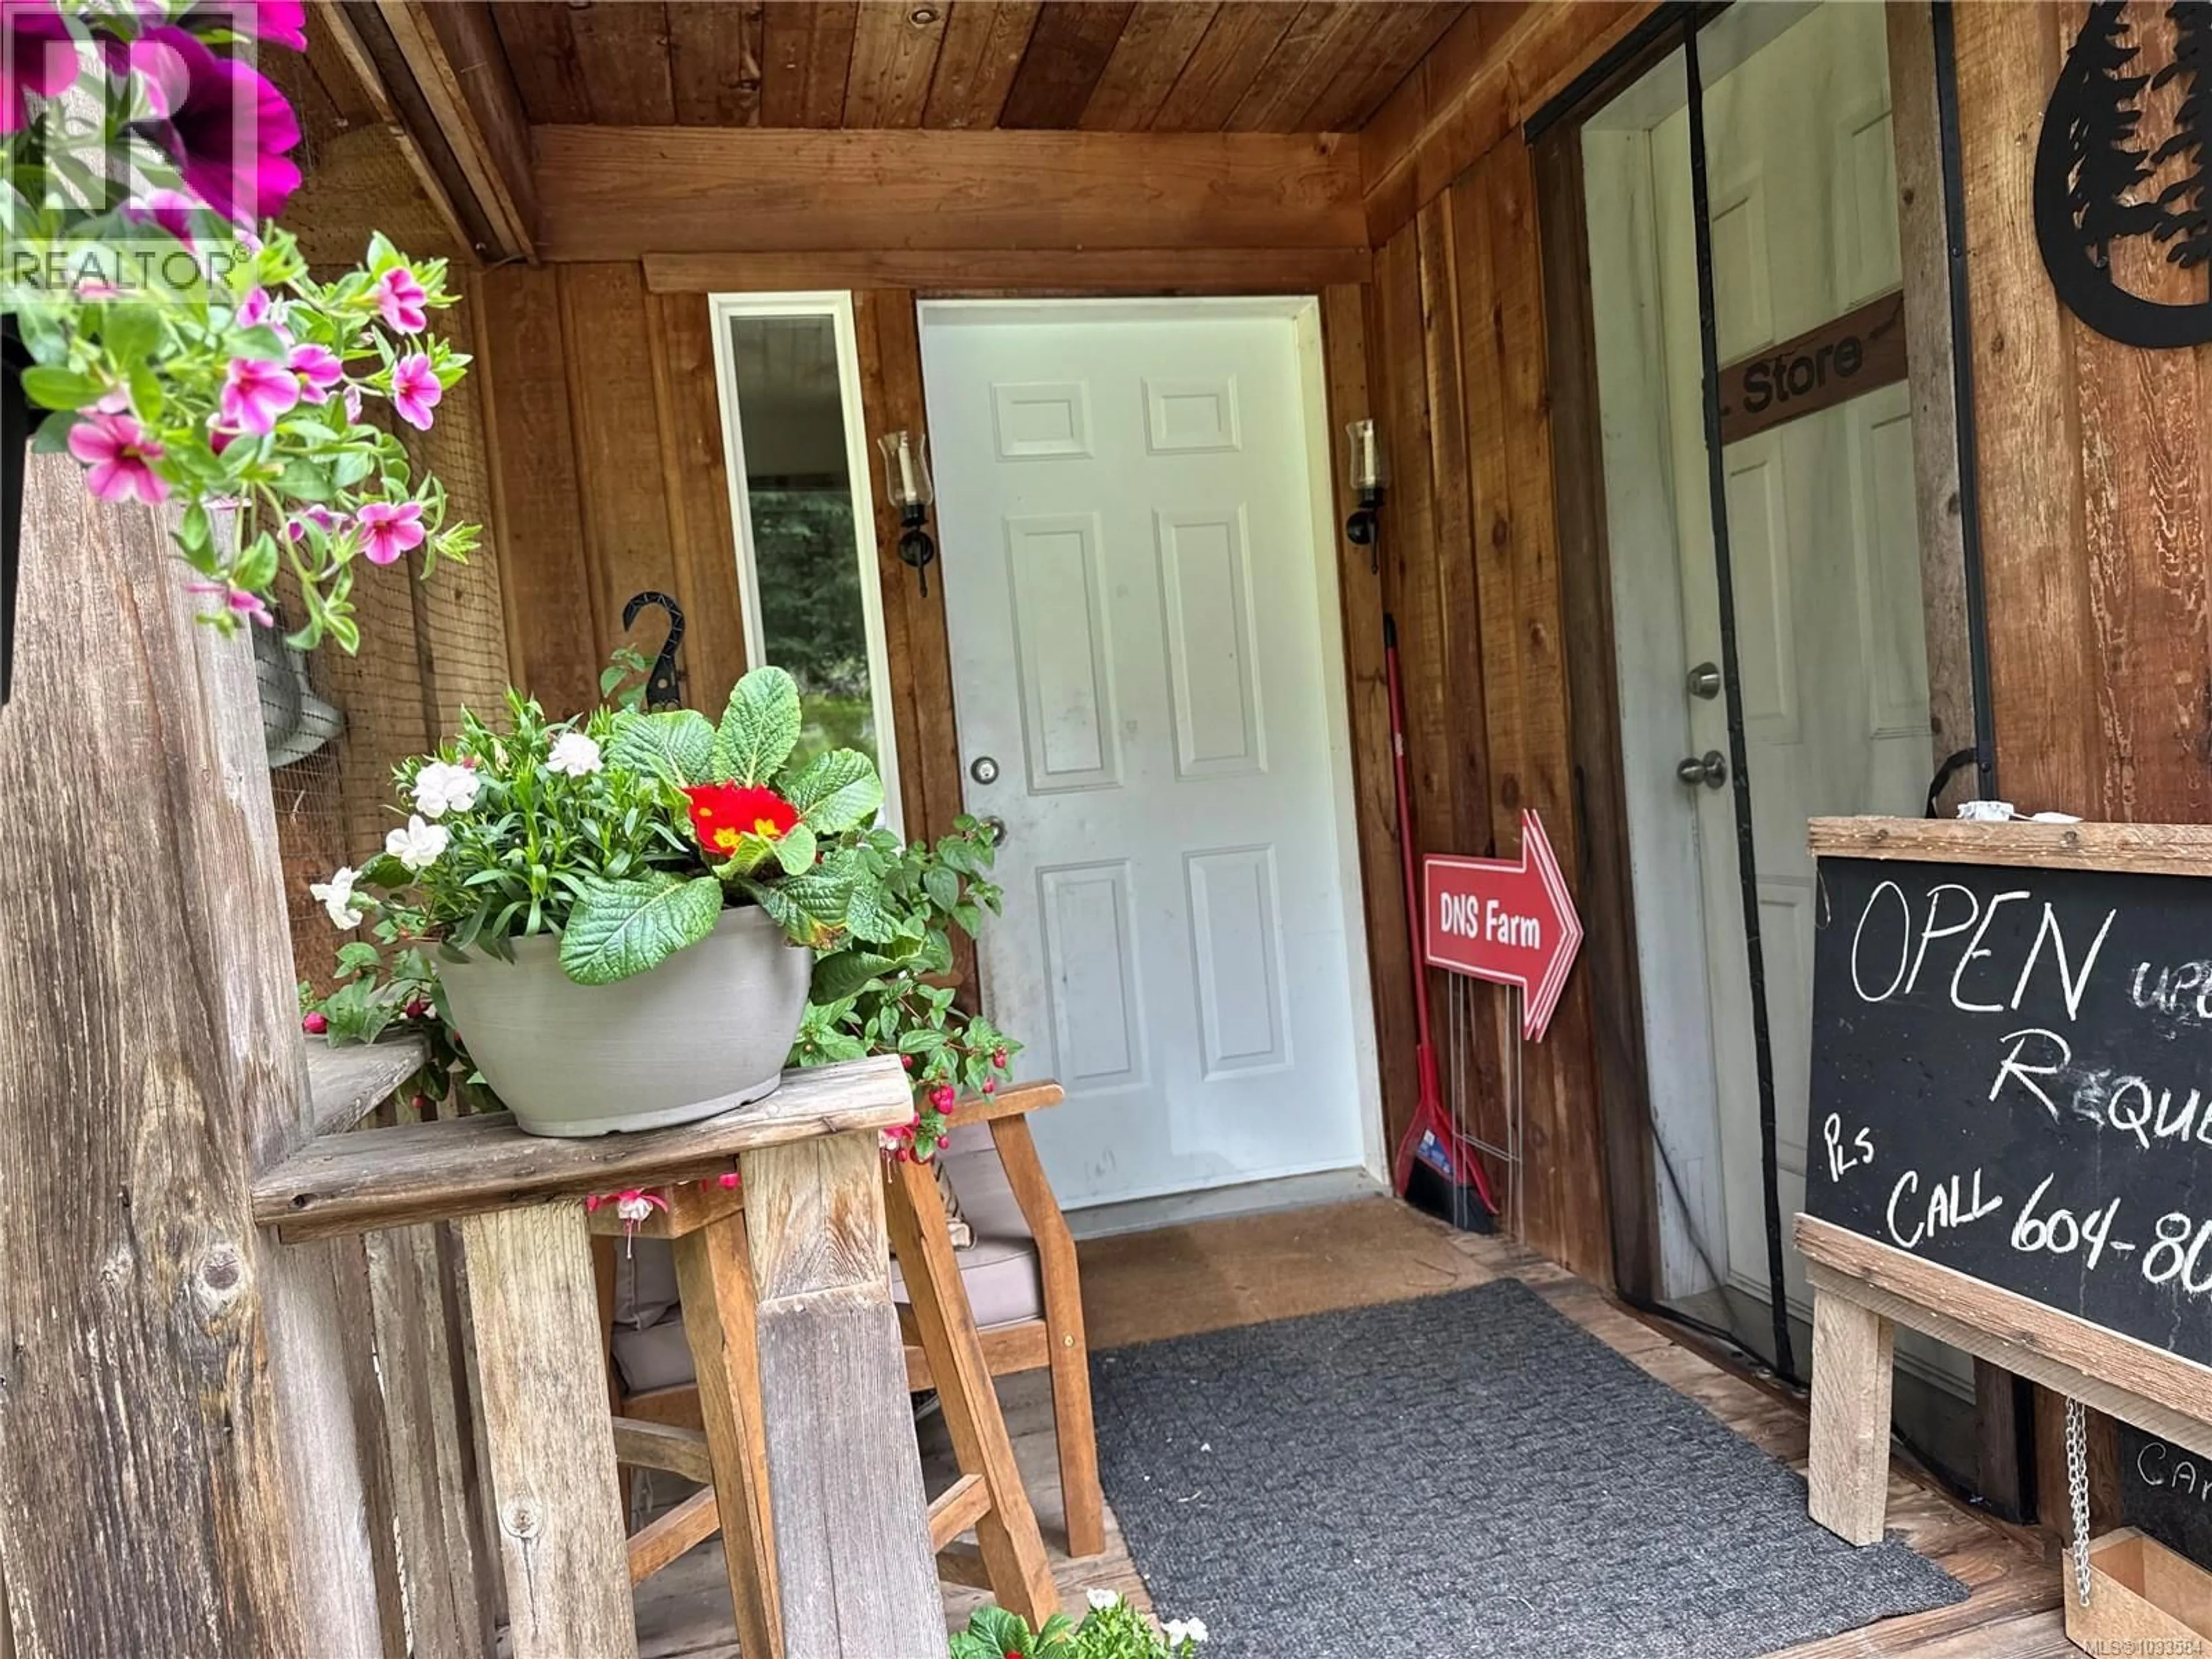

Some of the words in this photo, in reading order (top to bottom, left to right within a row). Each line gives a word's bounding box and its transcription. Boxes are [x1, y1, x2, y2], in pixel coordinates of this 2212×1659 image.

[1743, 336, 1863, 414] Store
[1441, 892, 1478, 939] DNS
[1486, 899, 1540, 950] Farm
[1851, 880, 2117, 1021] OPEN
[1887, 1167, 2003, 1248] CALL
